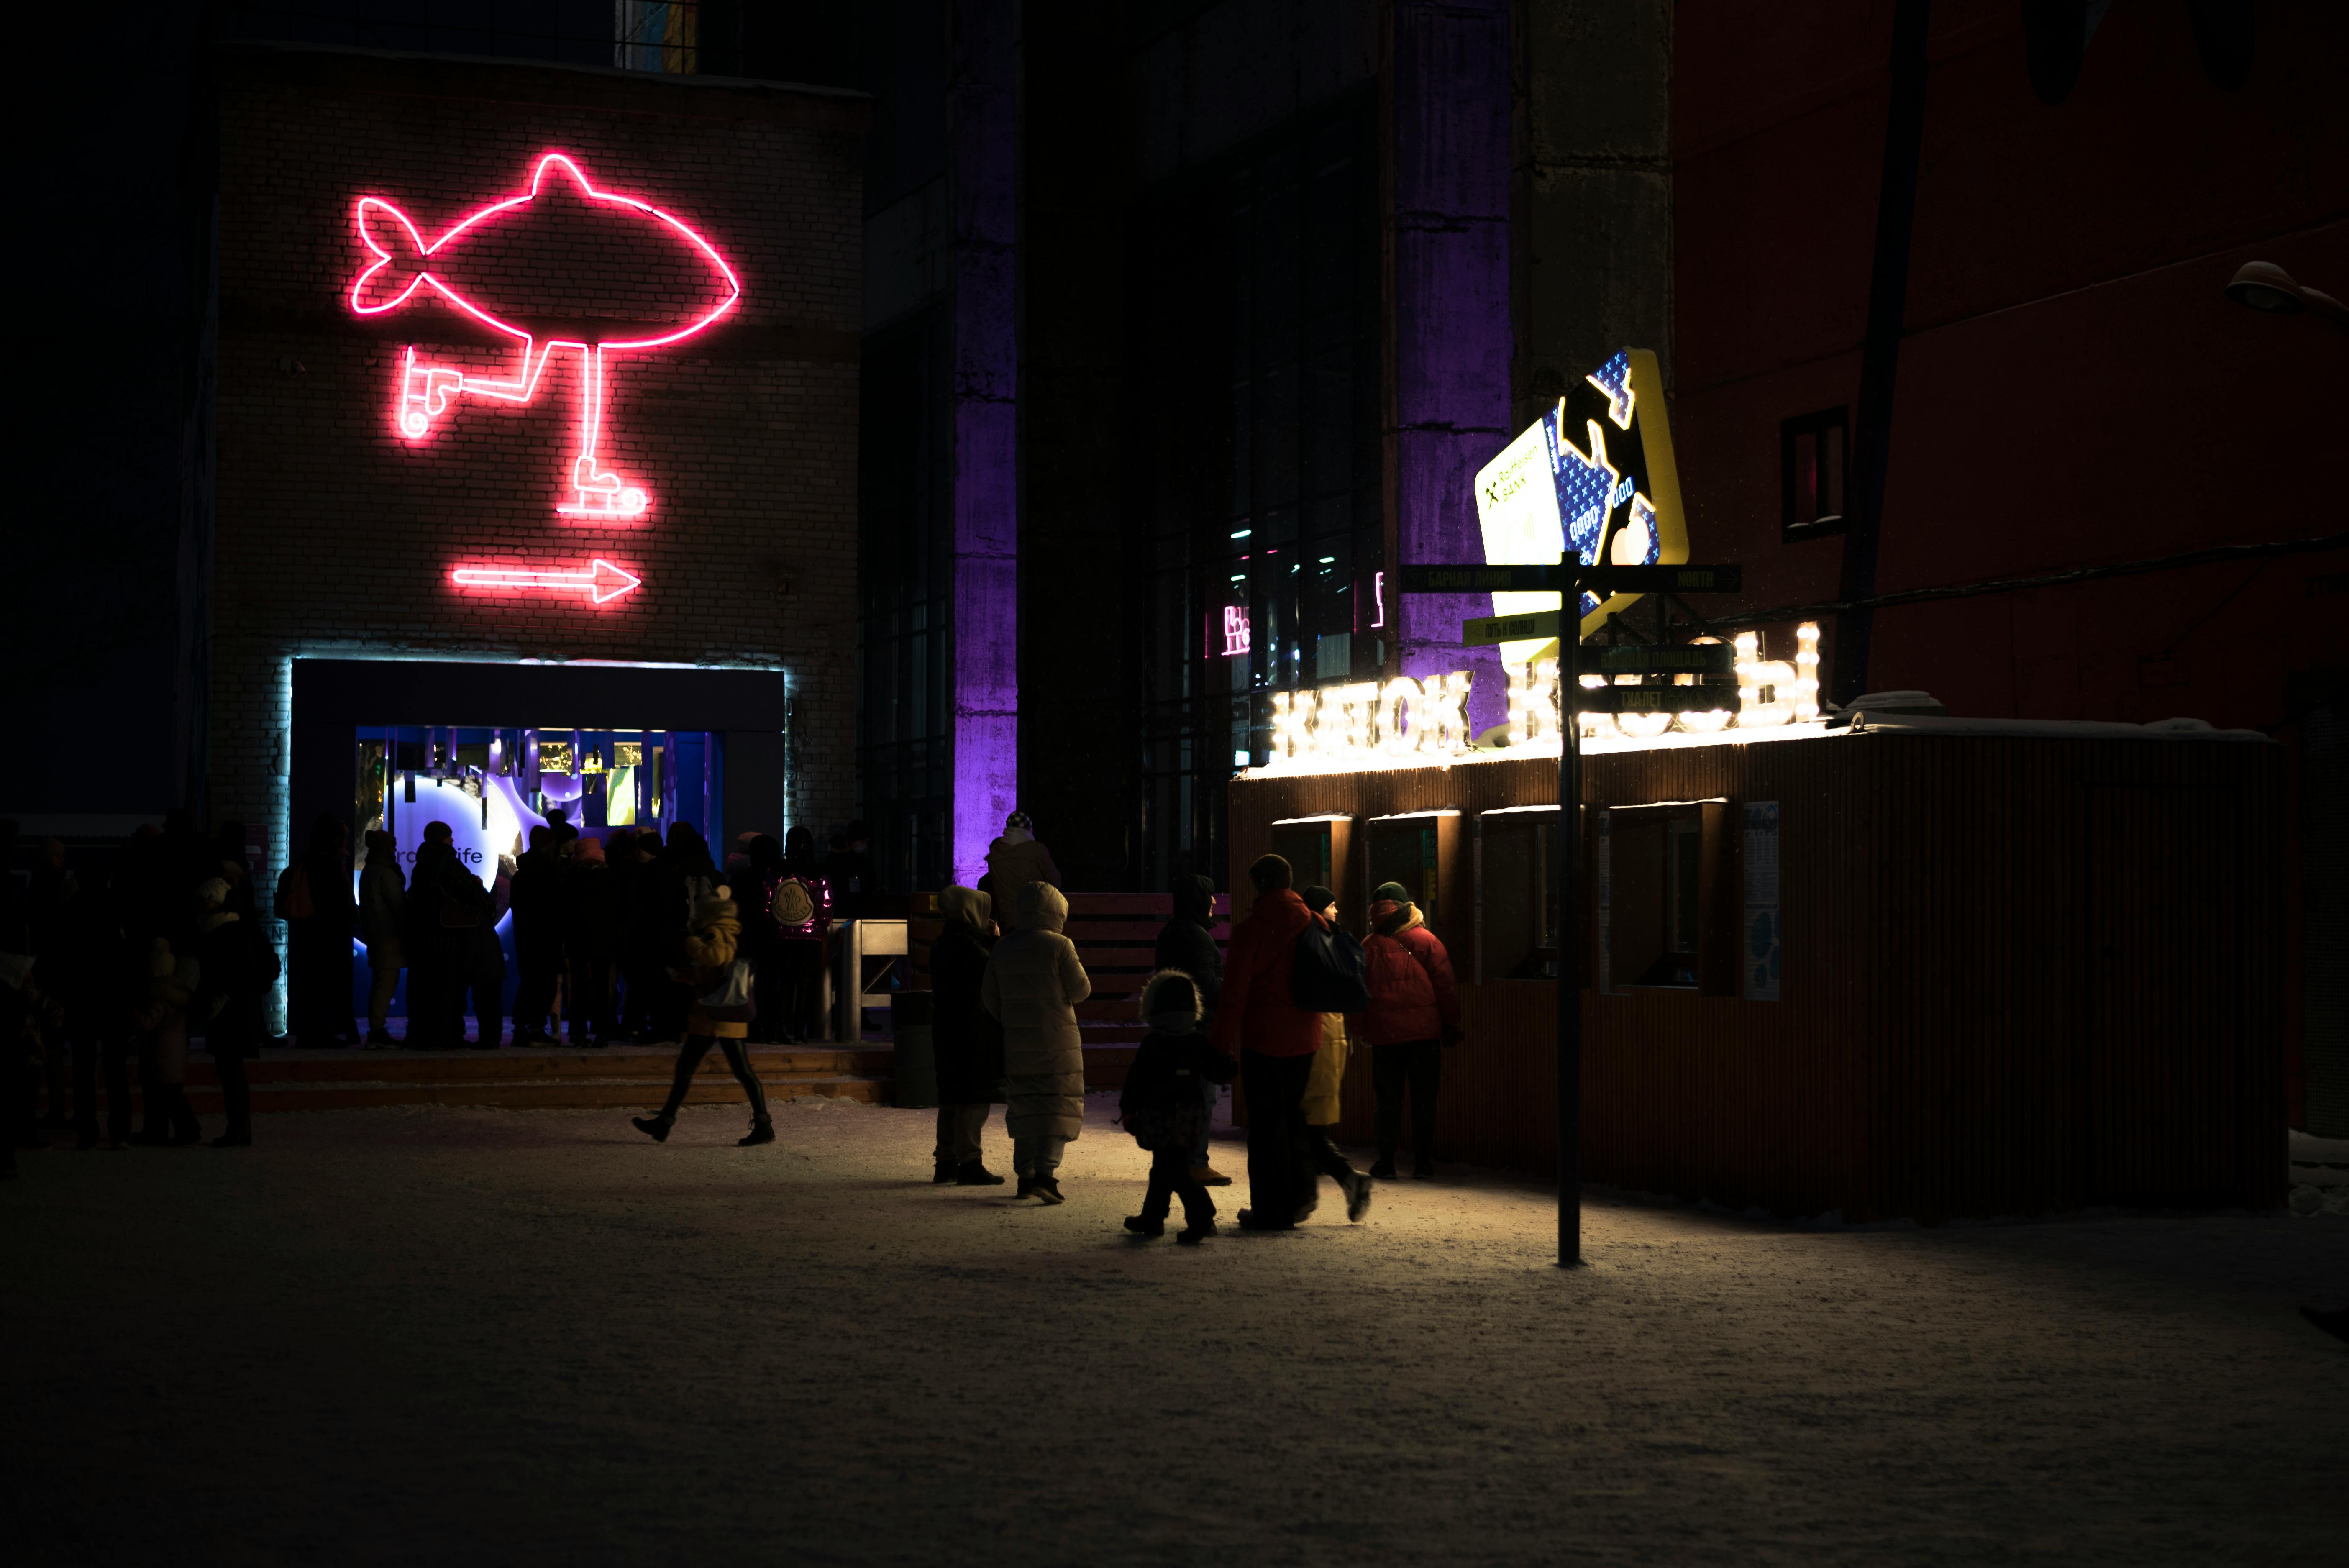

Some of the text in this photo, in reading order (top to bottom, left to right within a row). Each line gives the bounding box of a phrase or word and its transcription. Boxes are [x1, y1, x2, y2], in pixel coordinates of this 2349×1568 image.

[1499, 445, 1538, 485] Raiffeisen
[1503, 470, 1527, 502] BANK
[1427, 571, 1511, 587] БАРНАЯ ЛИНИЯ
[1677, 571, 1714, 587] NORTH
[1485, 619, 1535, 638] ПУТЬ К СОЛНЦУ
[1652, 651, 1706, 668] ПЛОЩАДЬ
[1620, 691, 1662, 707] ТУАЛЕТ
[1273, 671, 1475, 761] КАТОК
[776, 905, 809, 919] MONCLER
